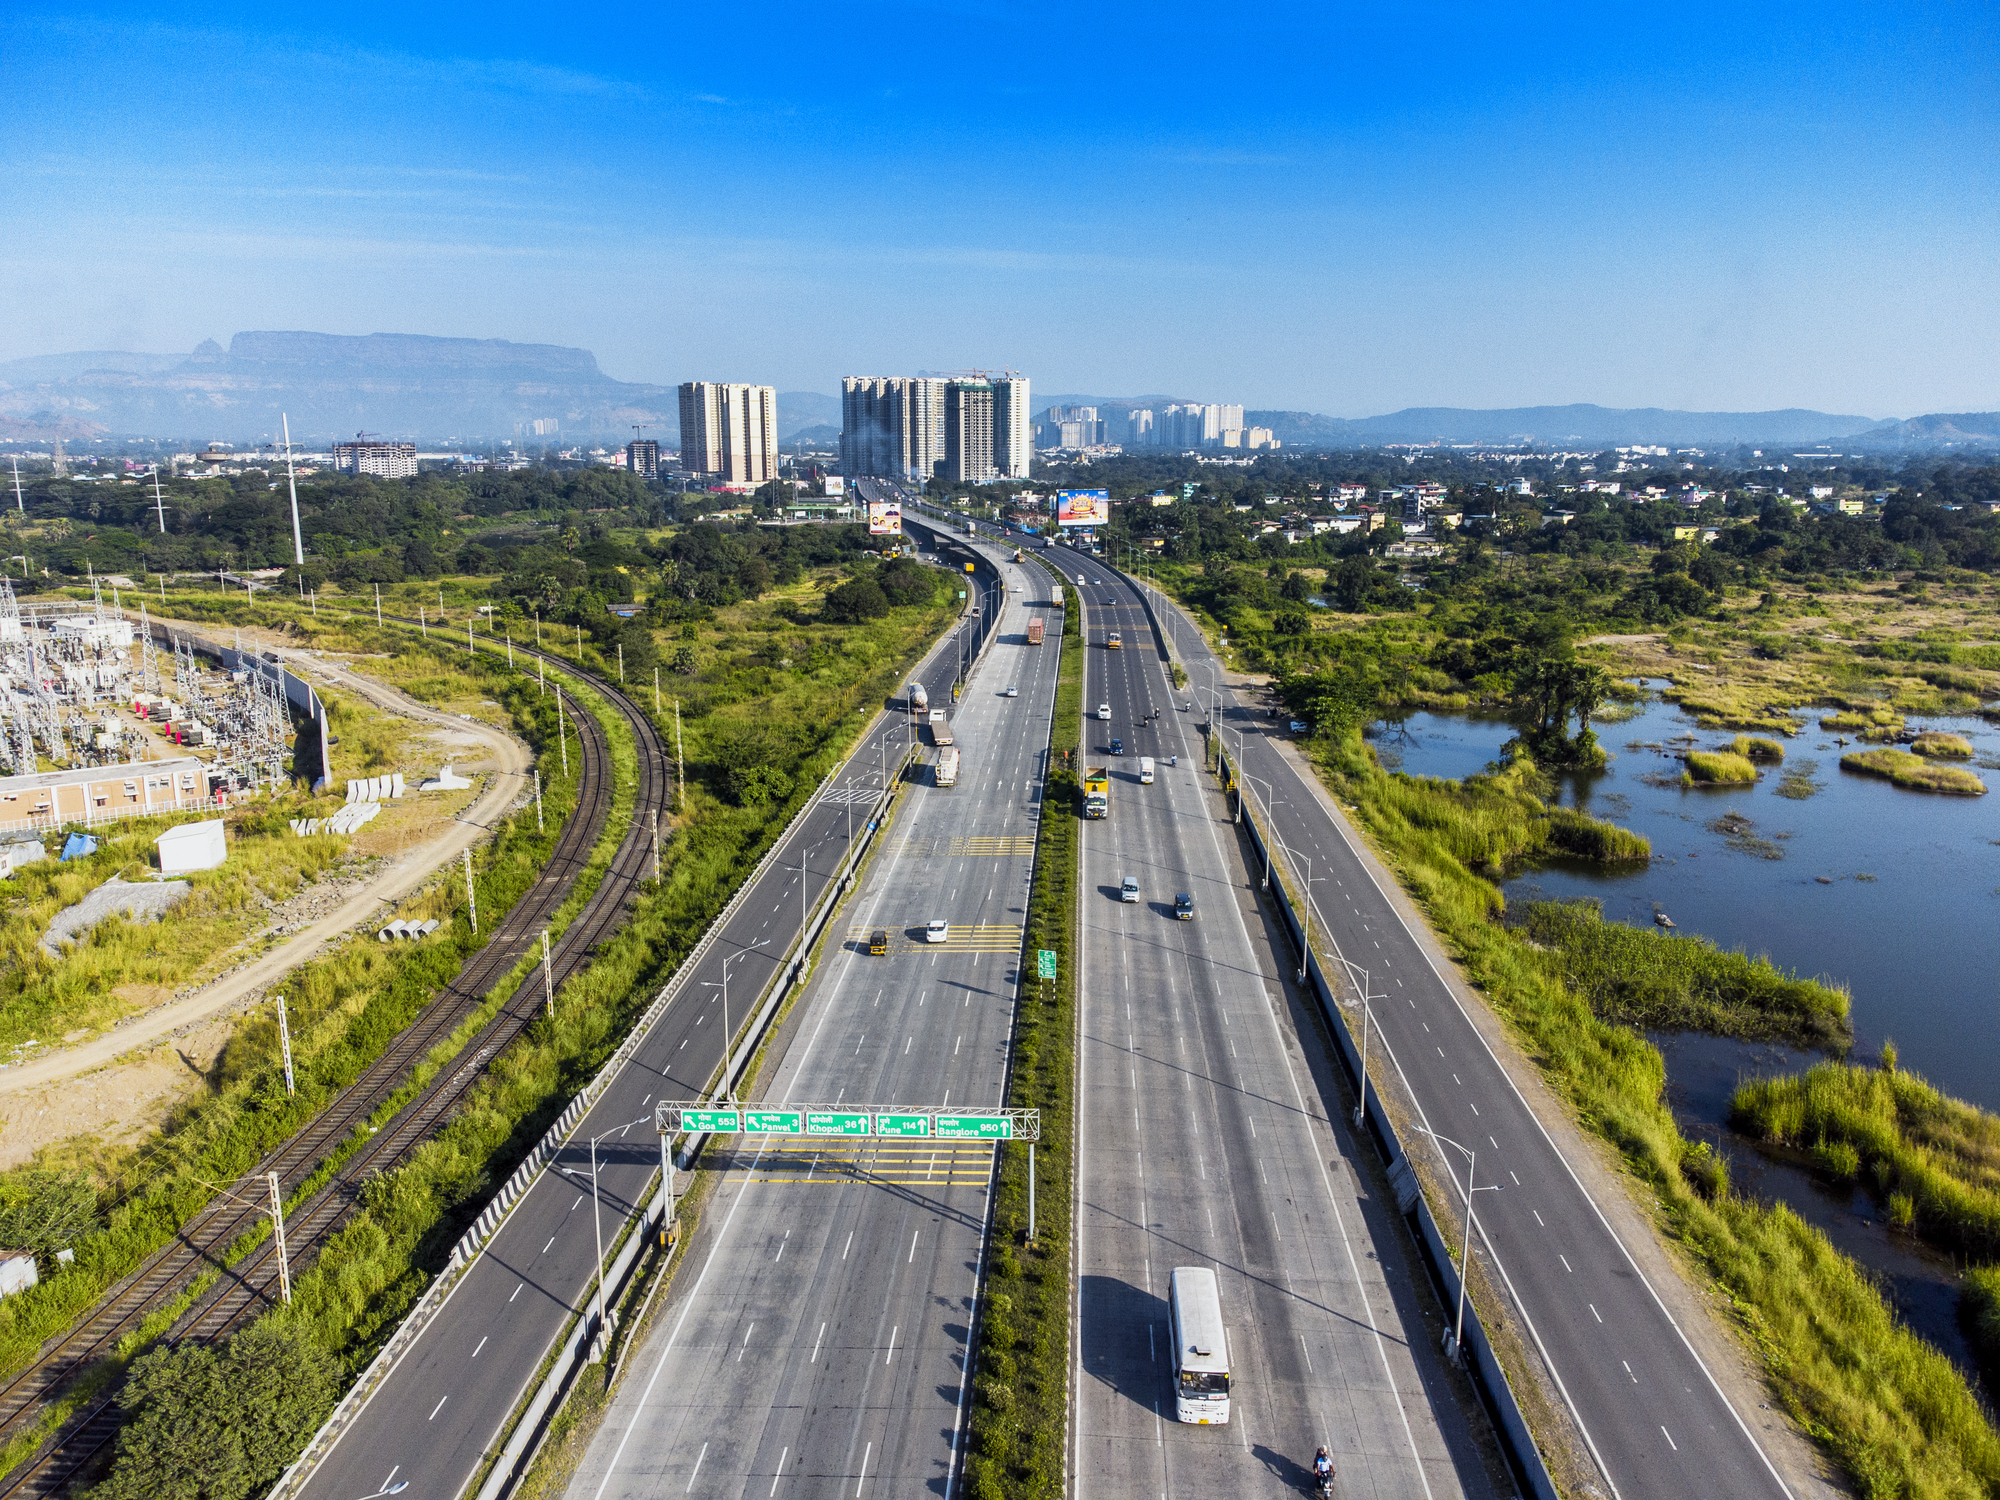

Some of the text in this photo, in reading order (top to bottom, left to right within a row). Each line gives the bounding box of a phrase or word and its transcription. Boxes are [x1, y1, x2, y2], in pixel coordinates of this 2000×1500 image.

[698, 1122, 716, 1130] Goa
[718, 1118, 736, 1126] 553
[844, 1120, 857, 1128] 36
[902, 1122, 916, 1130] 114
[762, 1123, 791, 1132] Panvel
[810, 1124, 844, 1133] Khopoli
[880, 1126, 902, 1134] Pune
[980, 1124, 998, 1132] 950
[938, 1128, 980, 1136] Banglore
